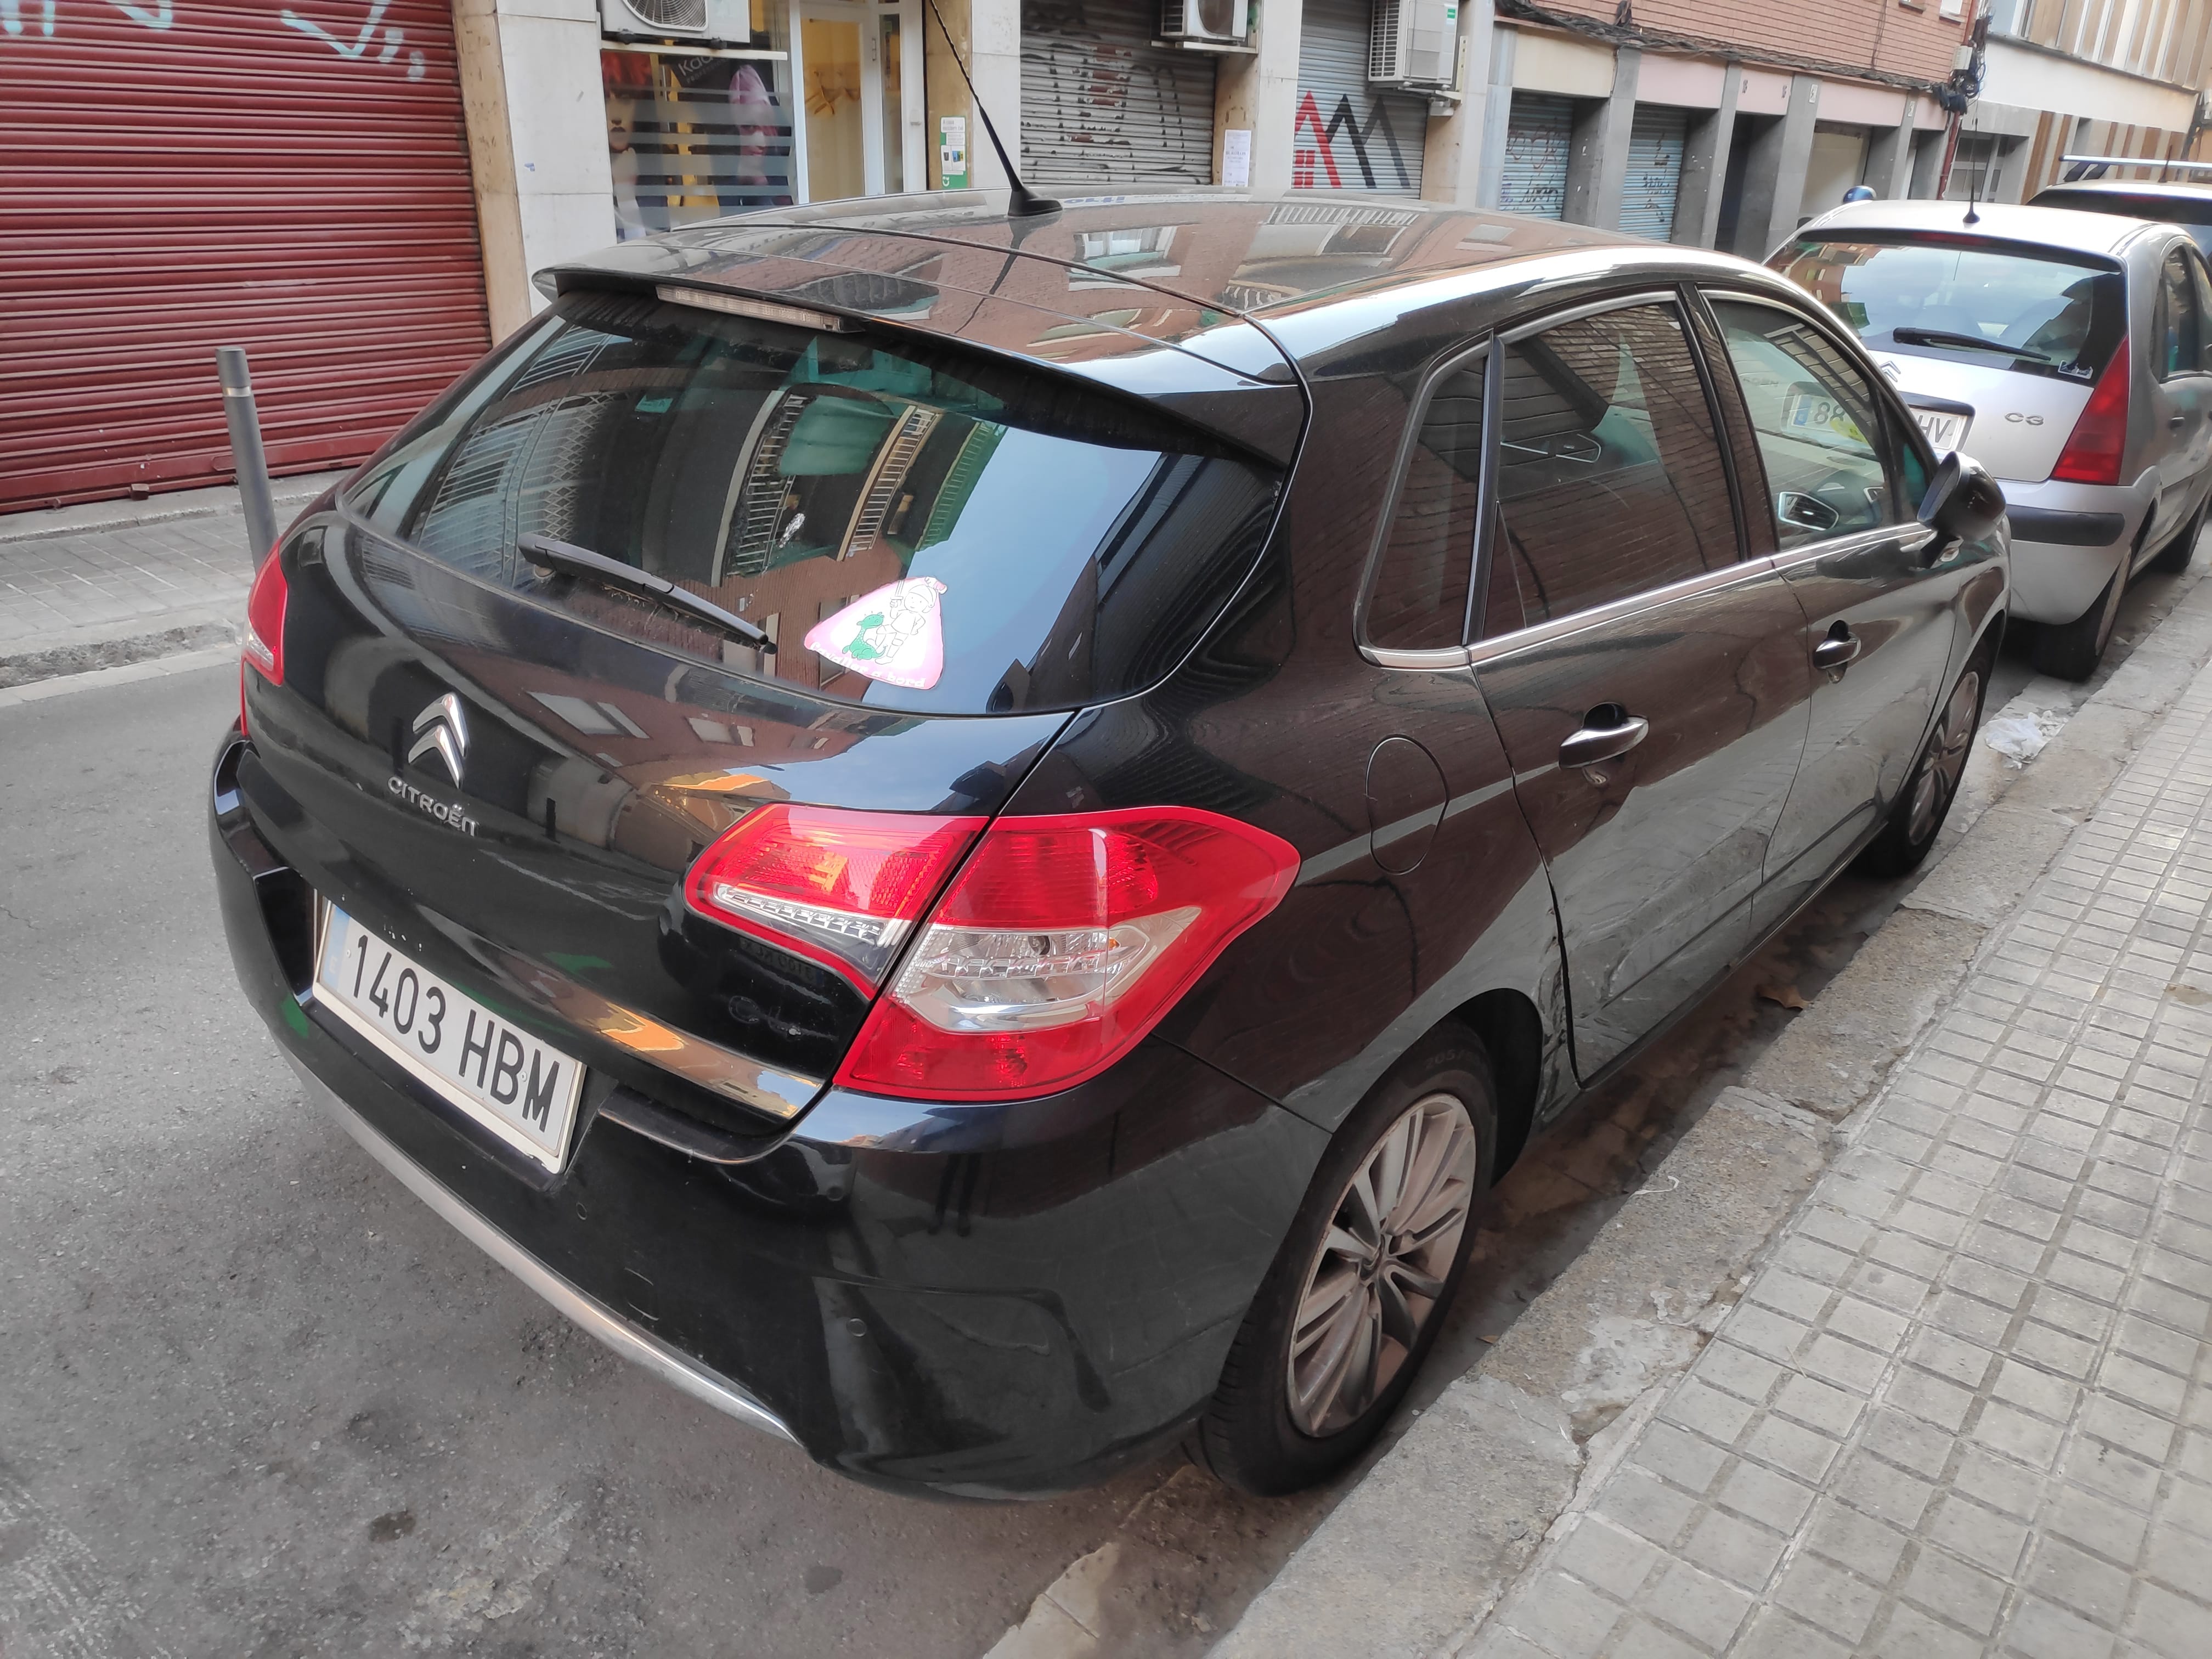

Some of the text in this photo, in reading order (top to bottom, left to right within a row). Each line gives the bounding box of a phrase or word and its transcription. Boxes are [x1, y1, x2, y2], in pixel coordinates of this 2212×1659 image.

[2004, 412, 2045, 426] C3
[887, 671, 926, 688] bord
[351, 934, 560, 1133] 1403 HBM
